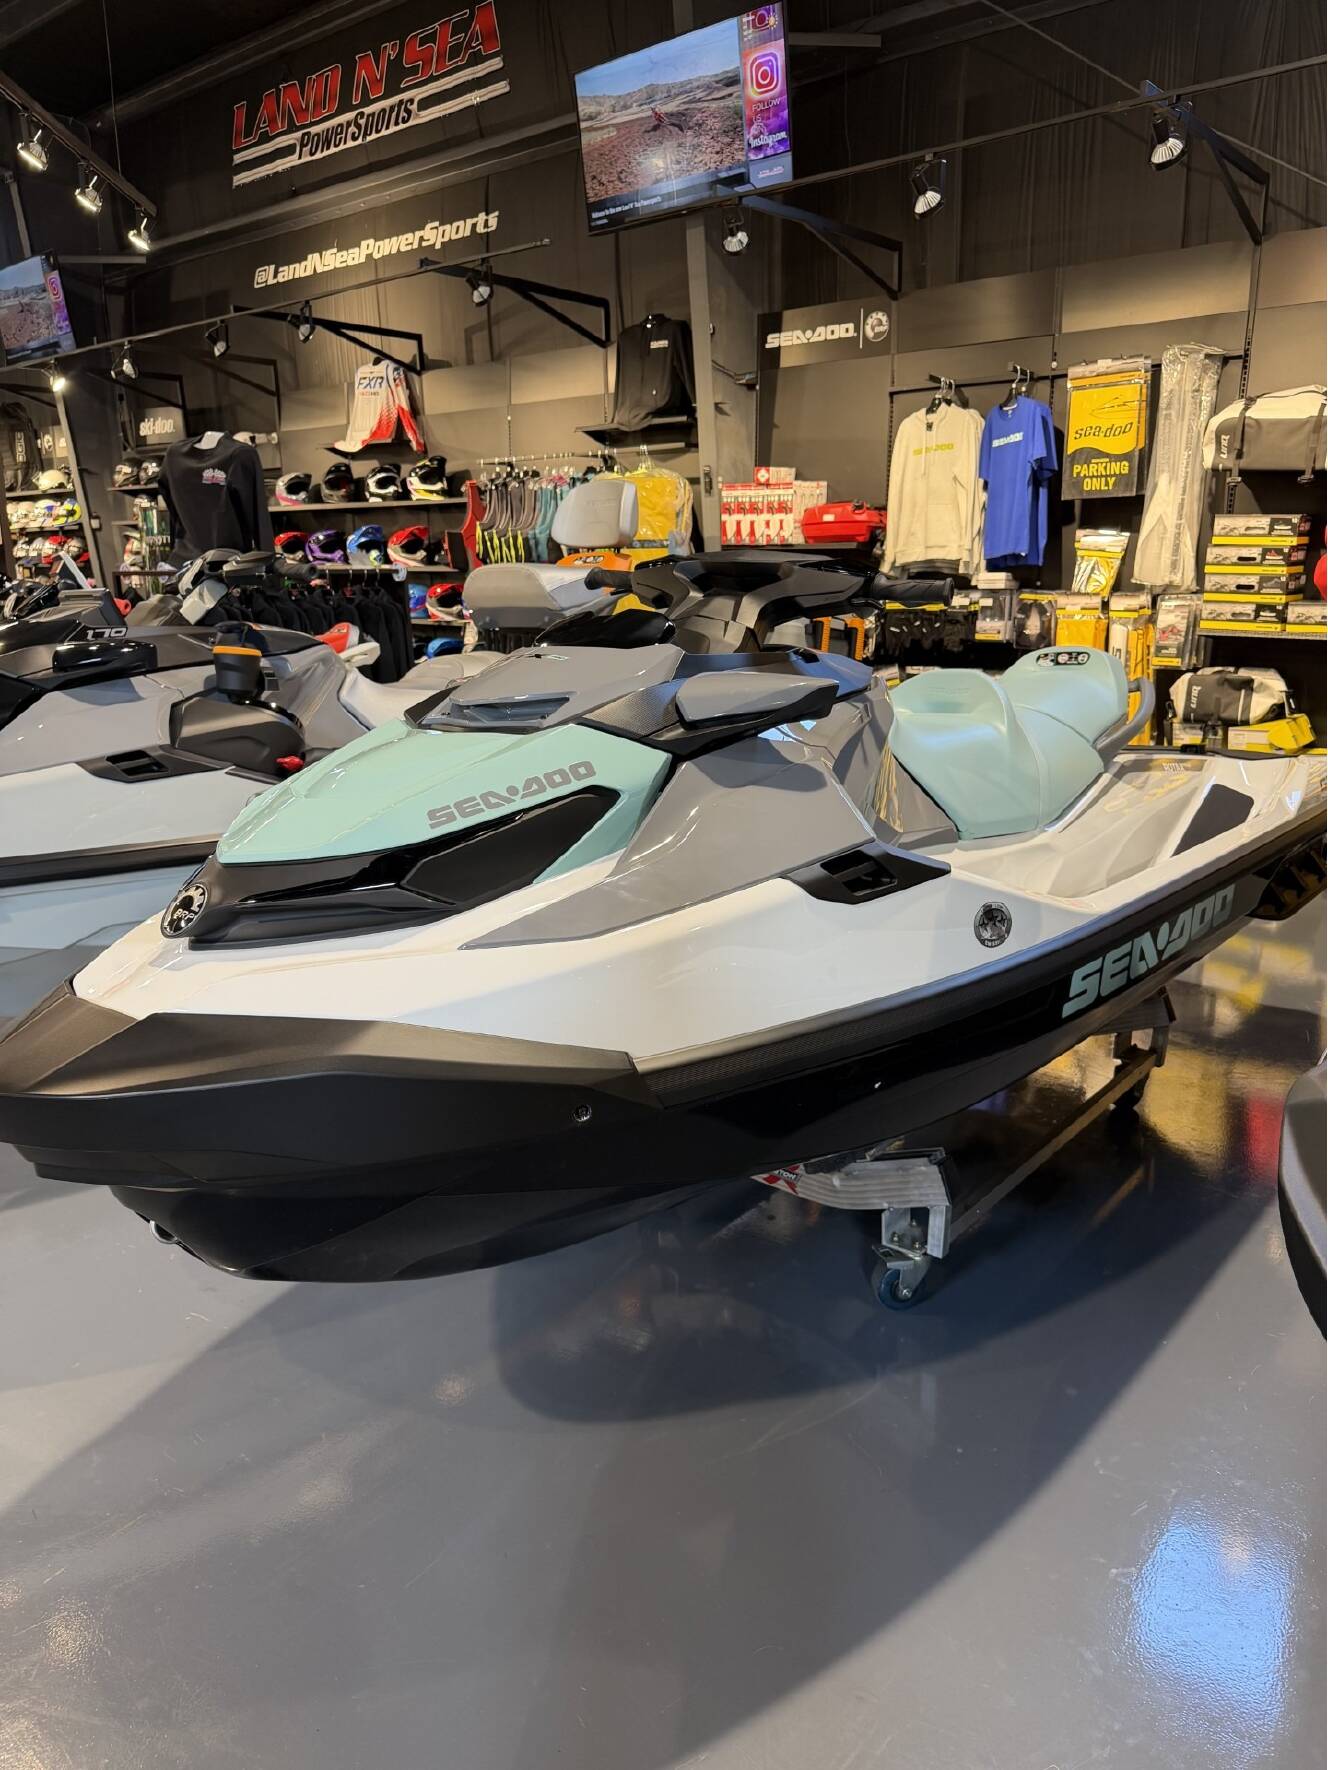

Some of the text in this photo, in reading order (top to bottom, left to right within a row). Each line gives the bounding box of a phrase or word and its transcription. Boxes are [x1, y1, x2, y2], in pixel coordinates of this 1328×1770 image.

[232, 64, 342, 149] LAND
[400, 0, 500, 88] SEA
[752, 98, 780, 112] FOLLOW
[298, 97, 415, 160] PowerSports
[254, 211, 499, 288] @LandNSeaPowerSports
[357, 376, 384, 389] FXR
[1073, 461, 1129, 477] PARKING
[1083, 477, 1116, 491] ONLY
[86, 627, 127, 641] 170
[173, 908, 195, 920] BRP
